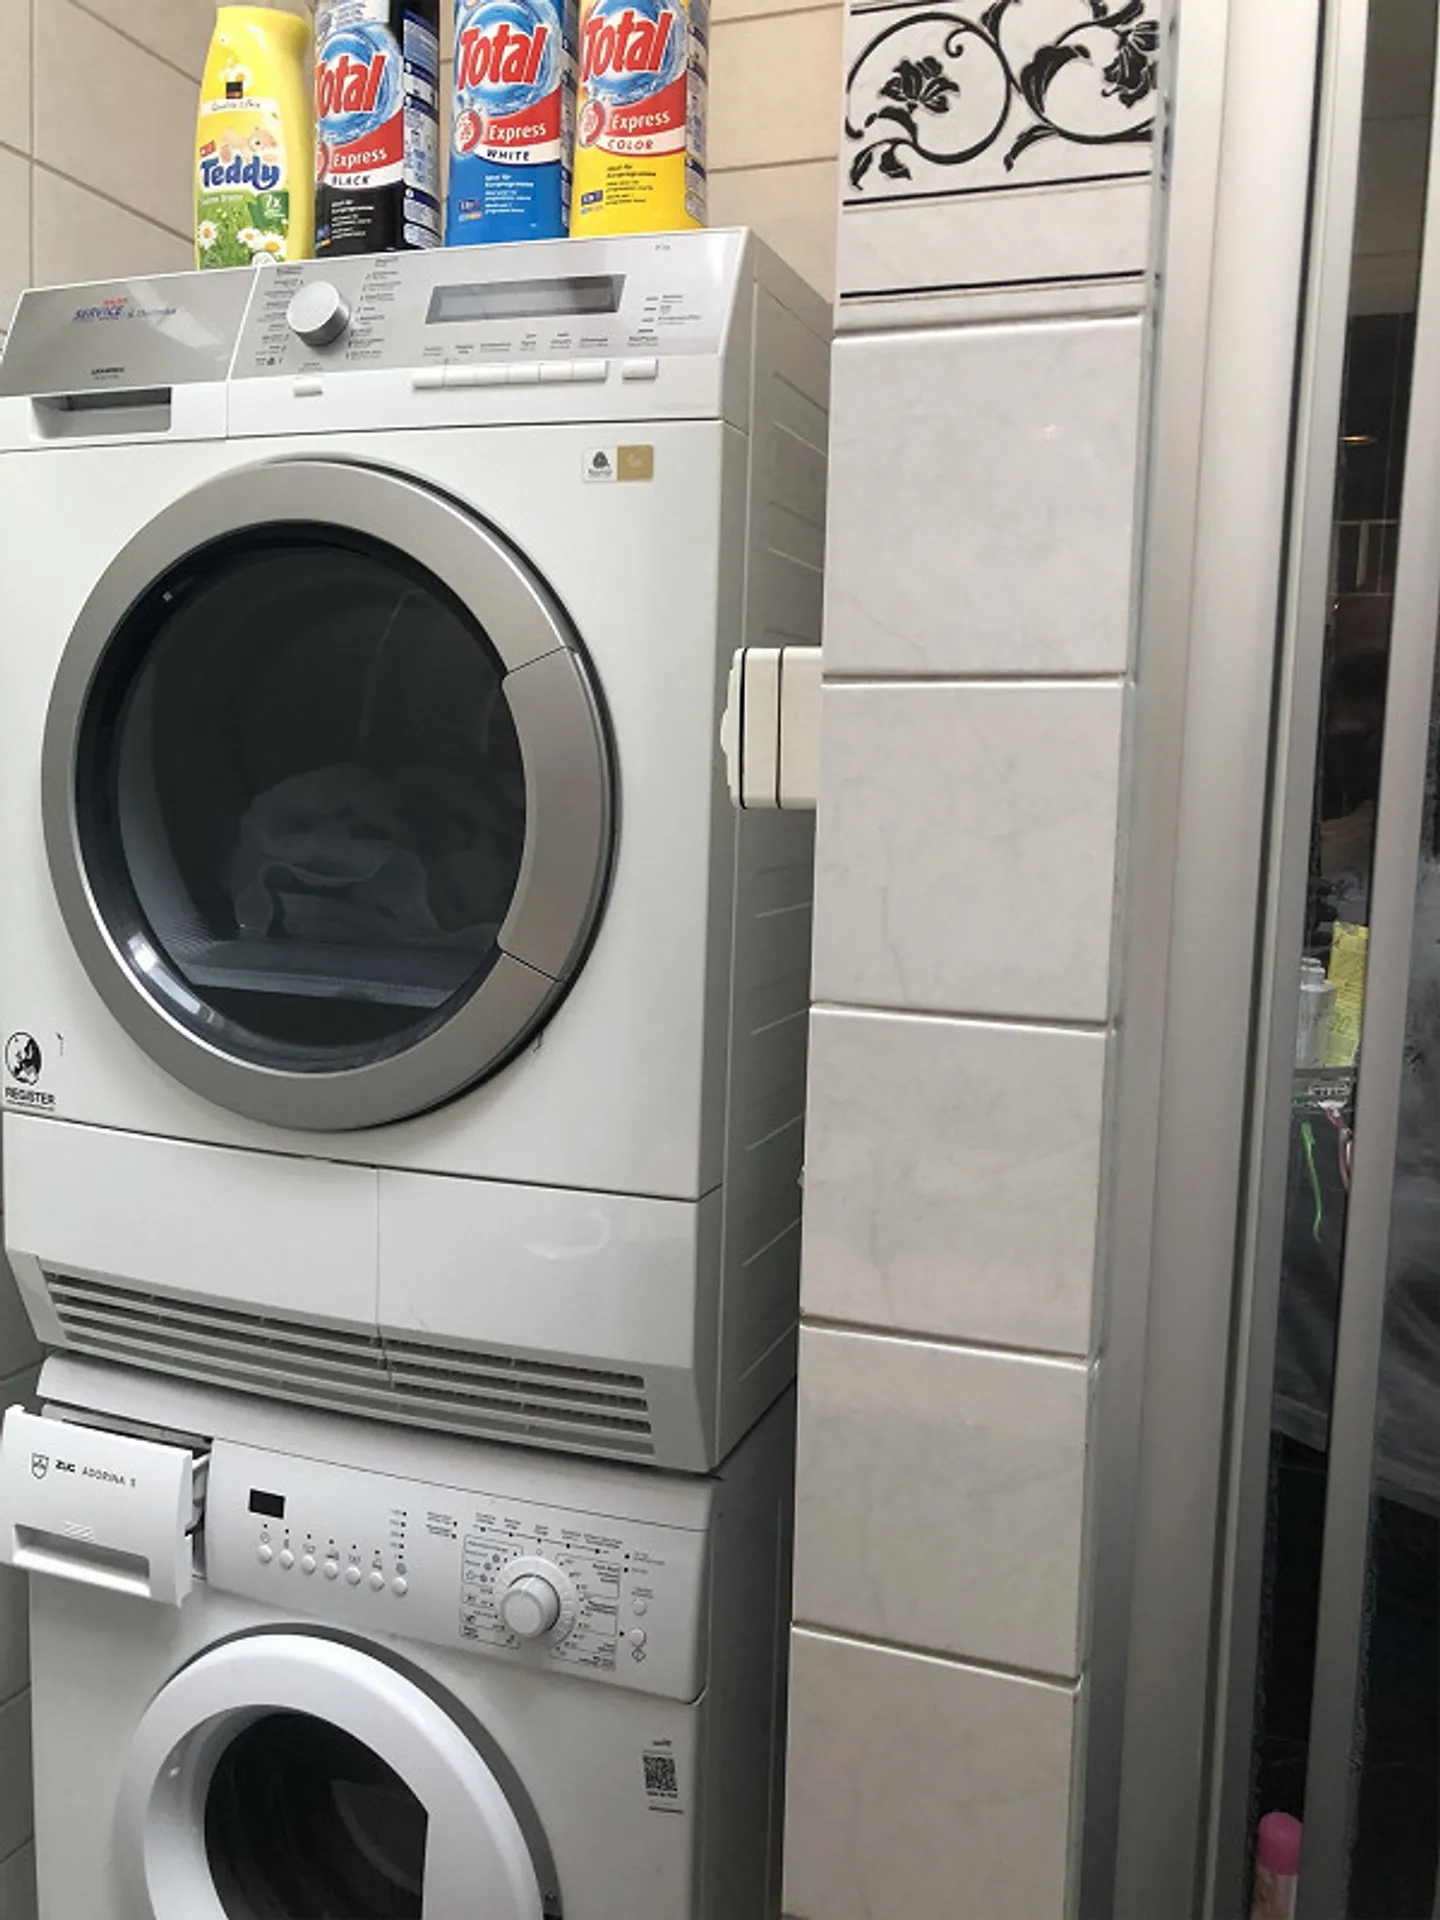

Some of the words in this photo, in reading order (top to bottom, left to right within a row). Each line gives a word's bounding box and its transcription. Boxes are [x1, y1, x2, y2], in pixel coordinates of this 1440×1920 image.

[458, 23, 548, 91] Total
[582, 10, 674, 83] Total
[611, 110, 672, 133] Express
[488, 122, 548, 144] Express
[486, 148, 531, 162] WHITE
[607, 139, 654, 150] COLOR
[332, 147, 388, 171] Express
[200, 152, 281, 191] Teddy
[331, 175, 371, 186] BLACK
[75, 305, 125, 320] SERVICE
